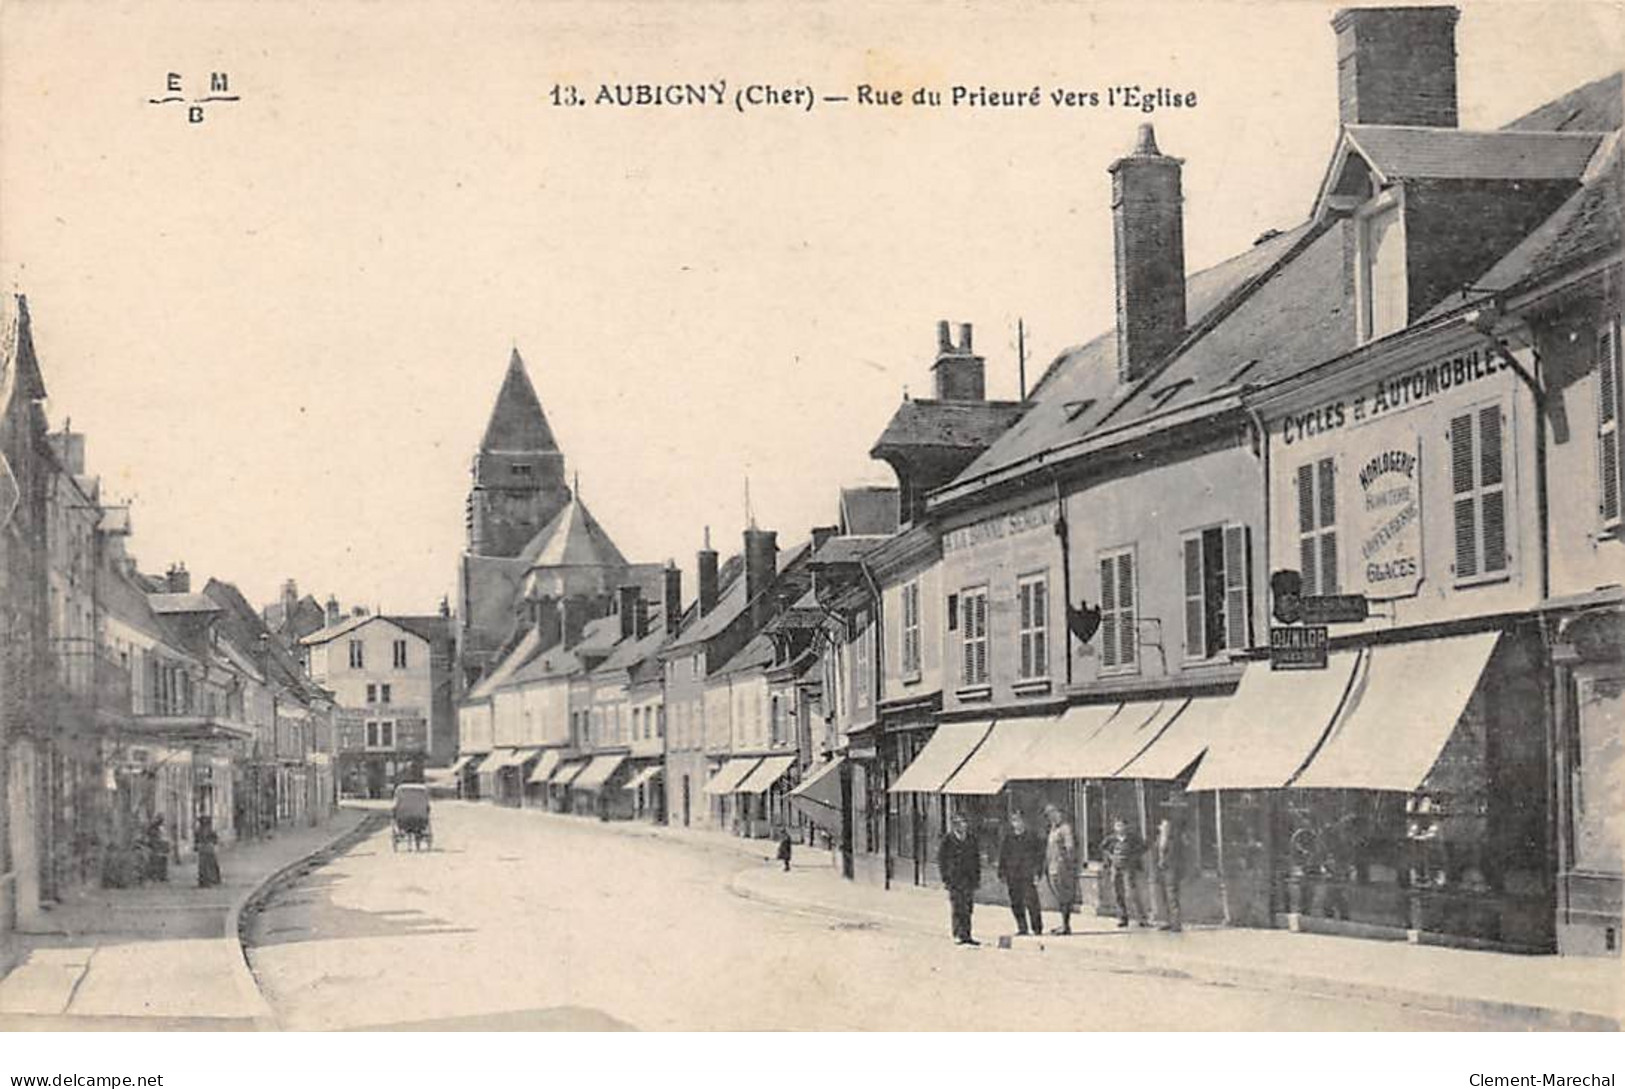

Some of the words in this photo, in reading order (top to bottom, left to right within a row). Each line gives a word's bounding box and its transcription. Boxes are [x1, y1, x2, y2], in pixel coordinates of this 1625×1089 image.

[1283, 399, 1346, 446] CYCLES
[1366, 557, 1416, 583] GLACES
[1272, 628, 1326, 650] DUNLOP
